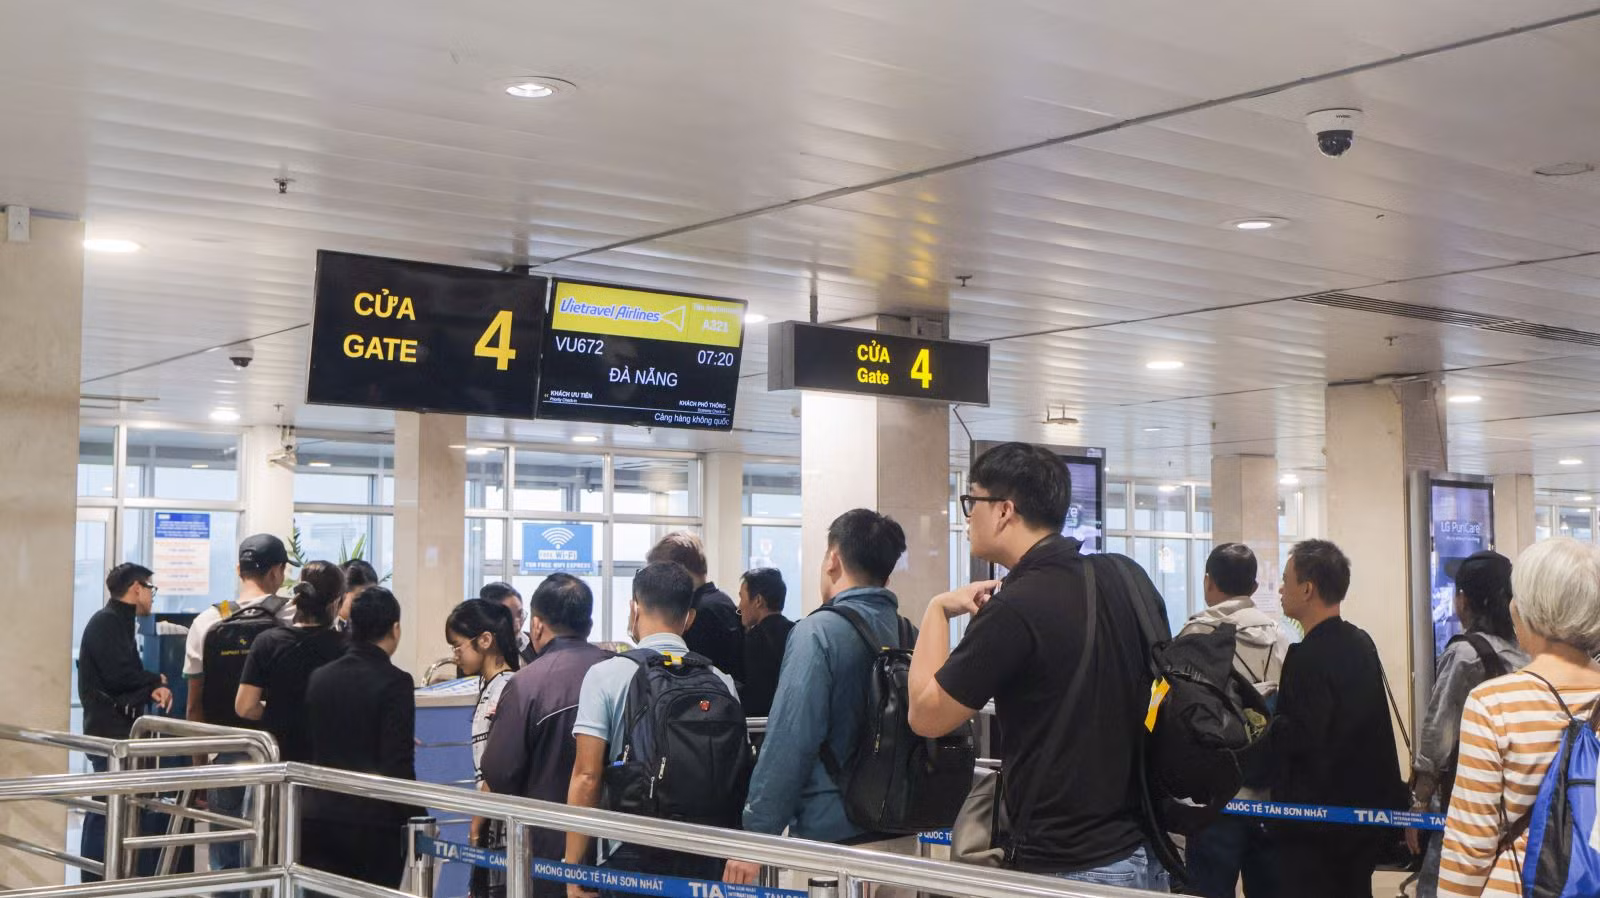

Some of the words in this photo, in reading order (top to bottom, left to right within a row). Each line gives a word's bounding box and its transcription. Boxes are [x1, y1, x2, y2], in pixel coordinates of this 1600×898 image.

[354, 288, 416, 321] CỬA
[559, 296, 614, 317] Vietravel
[614, 305, 661, 323] Airlines
[343, 334, 418, 363] GATE
[473, 310, 516, 371] 4
[555, 336, 604, 355] VU672
[697, 350, 734, 367] 07:20
[857, 340, 891, 364] CỬA
[609, 365, 630, 384] ĐÀ
[634, 366, 678, 387] NẴNG
[856, 367, 890, 385] Gate
[910, 348, 933, 389] 4
[550, 389, 570, 398] KHÁCH
[679, 399, 697, 407] KHÁCH
[654, 411, 673, 423] Cảng
[674, 413, 691, 424] hàng
[692, 414, 713, 426] không
[713, 415, 730, 427] quốc
[1440, 521, 1450, 533] LG
[1264, 804, 1282, 815] TÂN
[1283, 806, 1302, 817] SƠN
[1303, 807, 1328, 819] NHẤT
[1353, 809, 1390, 824] TIA
[433, 841, 459, 859] TIA
[534, 862, 563, 877] KHÔNG
[564, 865, 588, 881] QUỐC
[590, 869, 600, 882] TẾ
[601, 872, 618, 885] TÂN
[619, 874, 638, 888] SƠN
[639, 877, 664, 891] NHẤT
[688, 881, 725, 898] TIA
